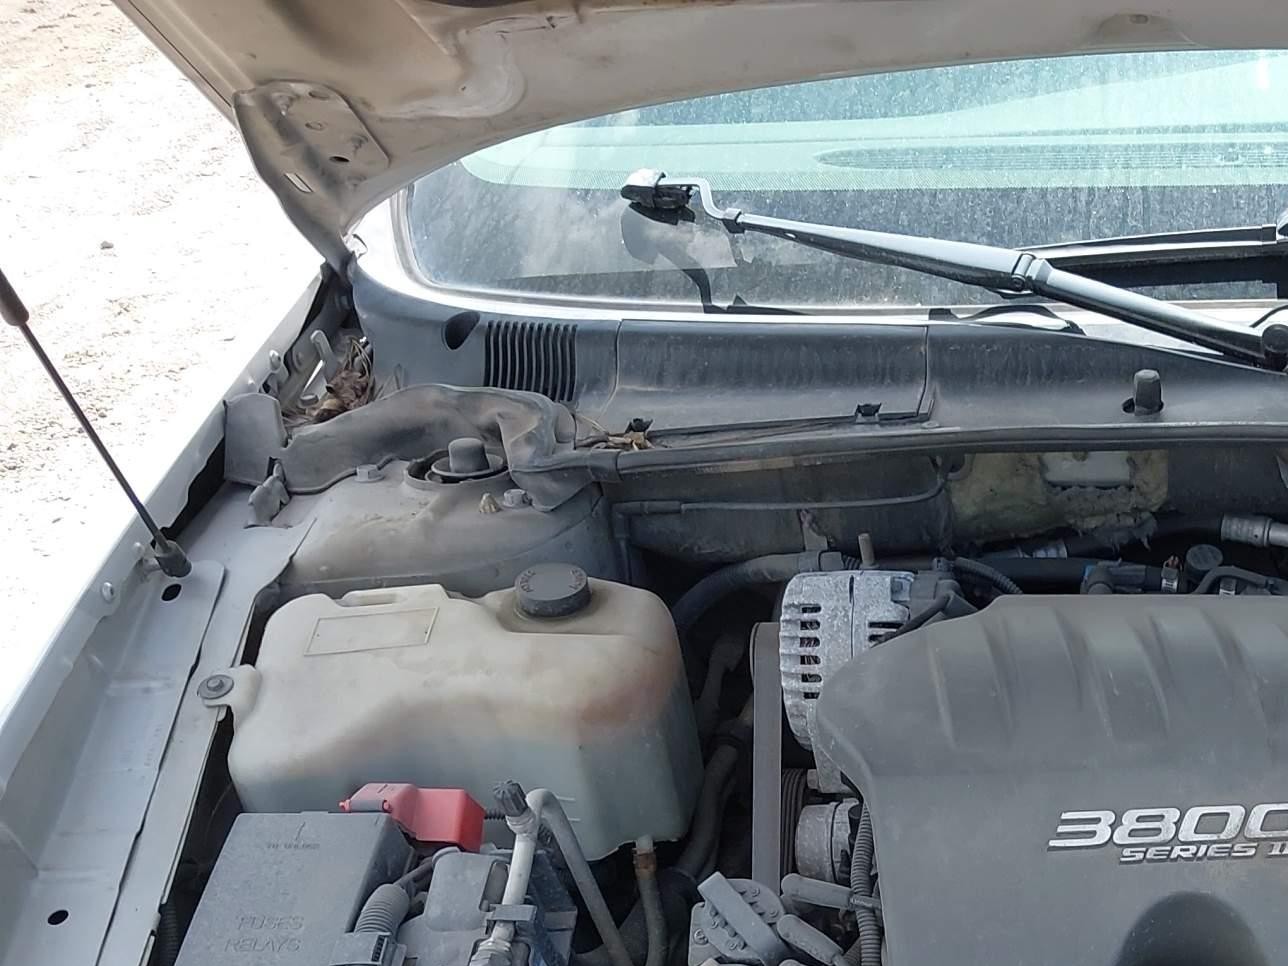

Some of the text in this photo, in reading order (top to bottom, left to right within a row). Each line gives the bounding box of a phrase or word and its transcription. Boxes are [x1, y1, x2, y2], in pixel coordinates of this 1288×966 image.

[1119, 841, 1259, 863] SERIES
[234, 914, 305, 931] FUSES
[224, 936, 302, 954] RELAYS
